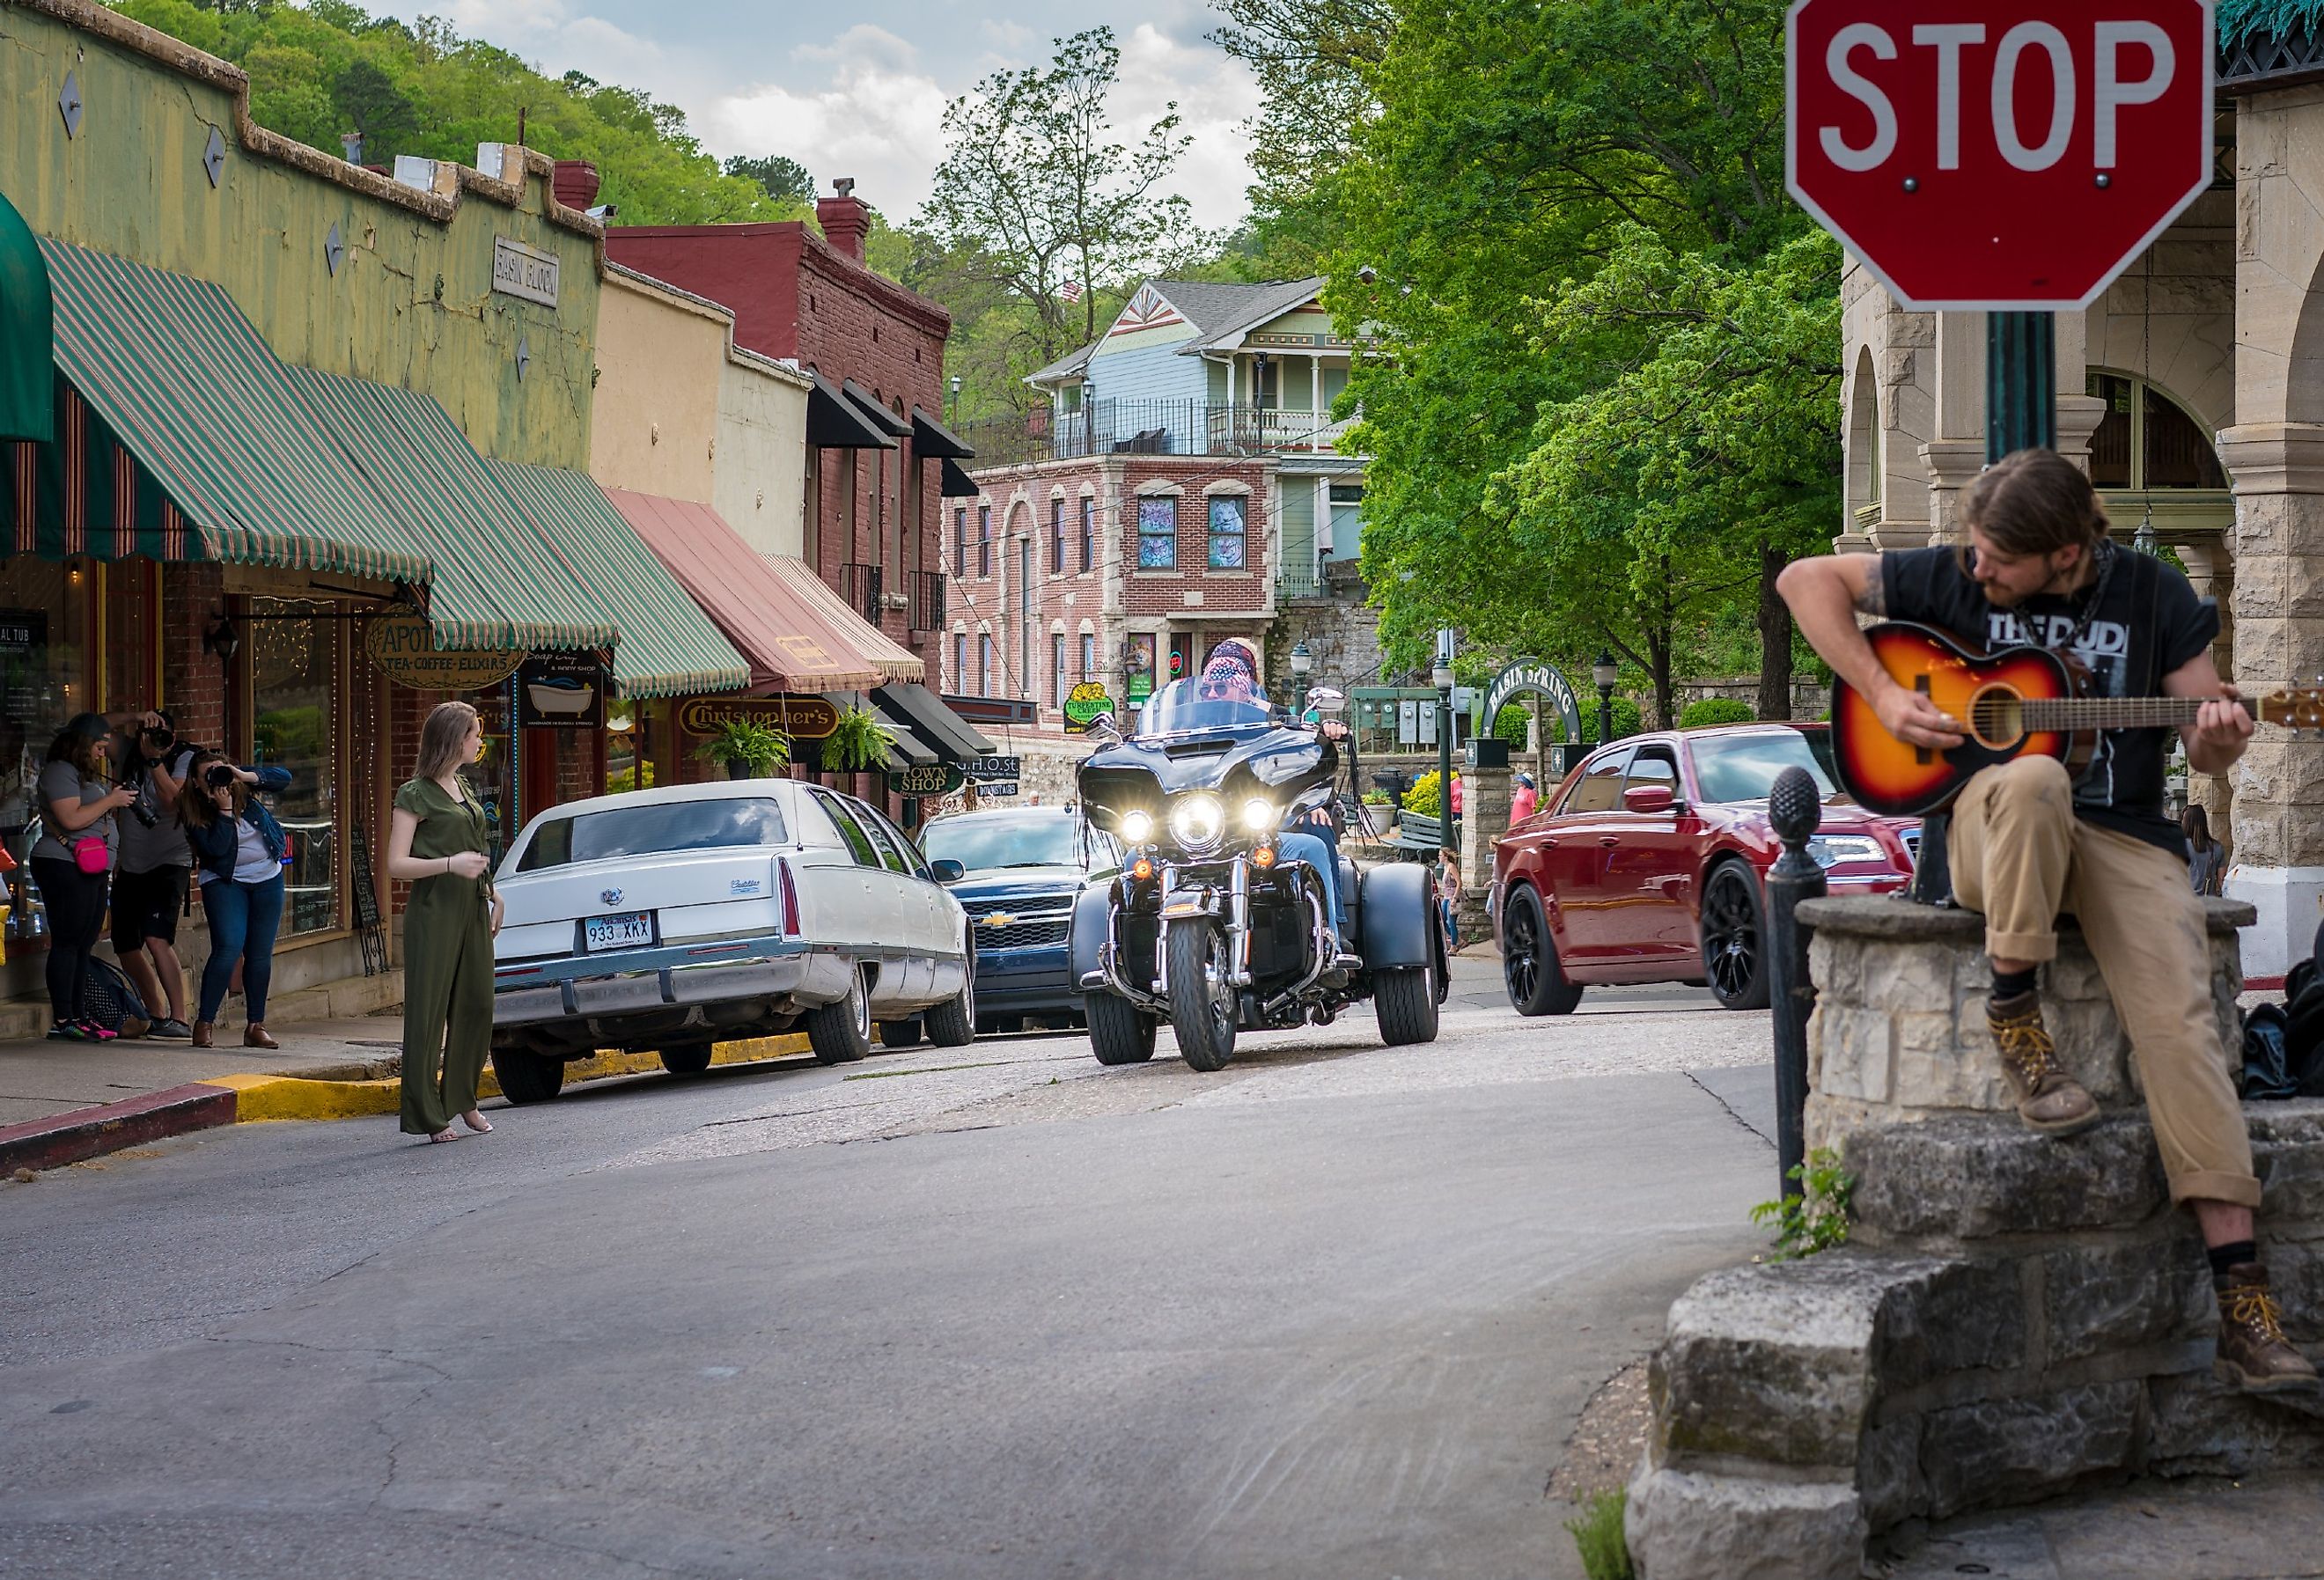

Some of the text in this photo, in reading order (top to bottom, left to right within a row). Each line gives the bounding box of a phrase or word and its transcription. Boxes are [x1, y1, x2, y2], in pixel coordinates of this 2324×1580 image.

[1819, 19, 2176, 173] STOP
[496, 252, 556, 298] BASIN BLOCK
[13, 628, 29, 642] TUB
[2046, 615, 2129, 655] DUD
[526, 650, 553, 665] Soap
[1489, 665, 1523, 715] BASIN
[688, 702, 828, 730] Christopher's
[901, 778, 946, 791] SHOP
[589, 922, 649, 943] 933 XKX
[601, 915, 637, 926] Arkansas
